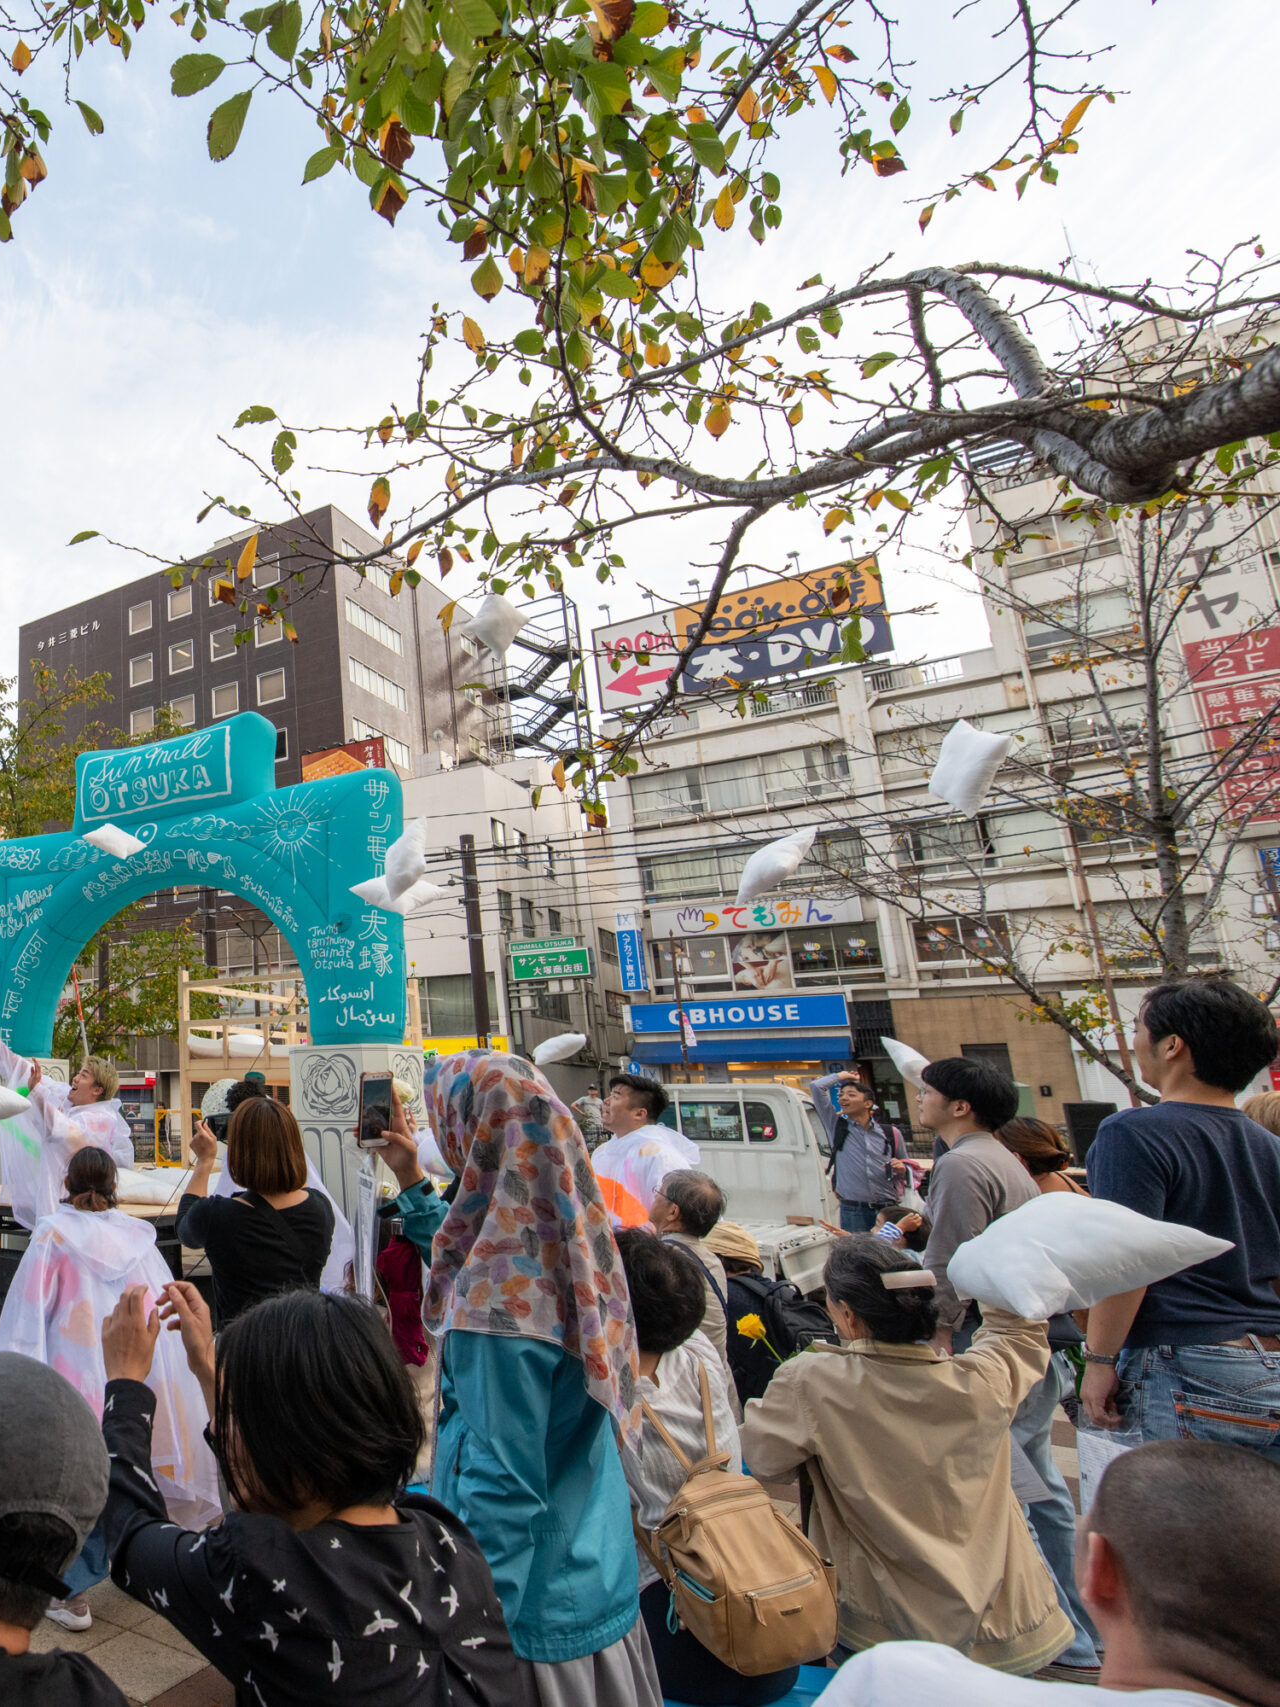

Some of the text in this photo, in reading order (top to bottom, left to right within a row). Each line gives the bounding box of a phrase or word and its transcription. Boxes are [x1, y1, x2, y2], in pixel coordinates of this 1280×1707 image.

[90, 764, 212, 812] OTSUKA
[722, 899, 833, 928] てもみん
[544, 940, 572, 949] OTSUKA
[518, 955, 568, 967] サンモール
[533, 963, 583, 976] 大塚商店街
